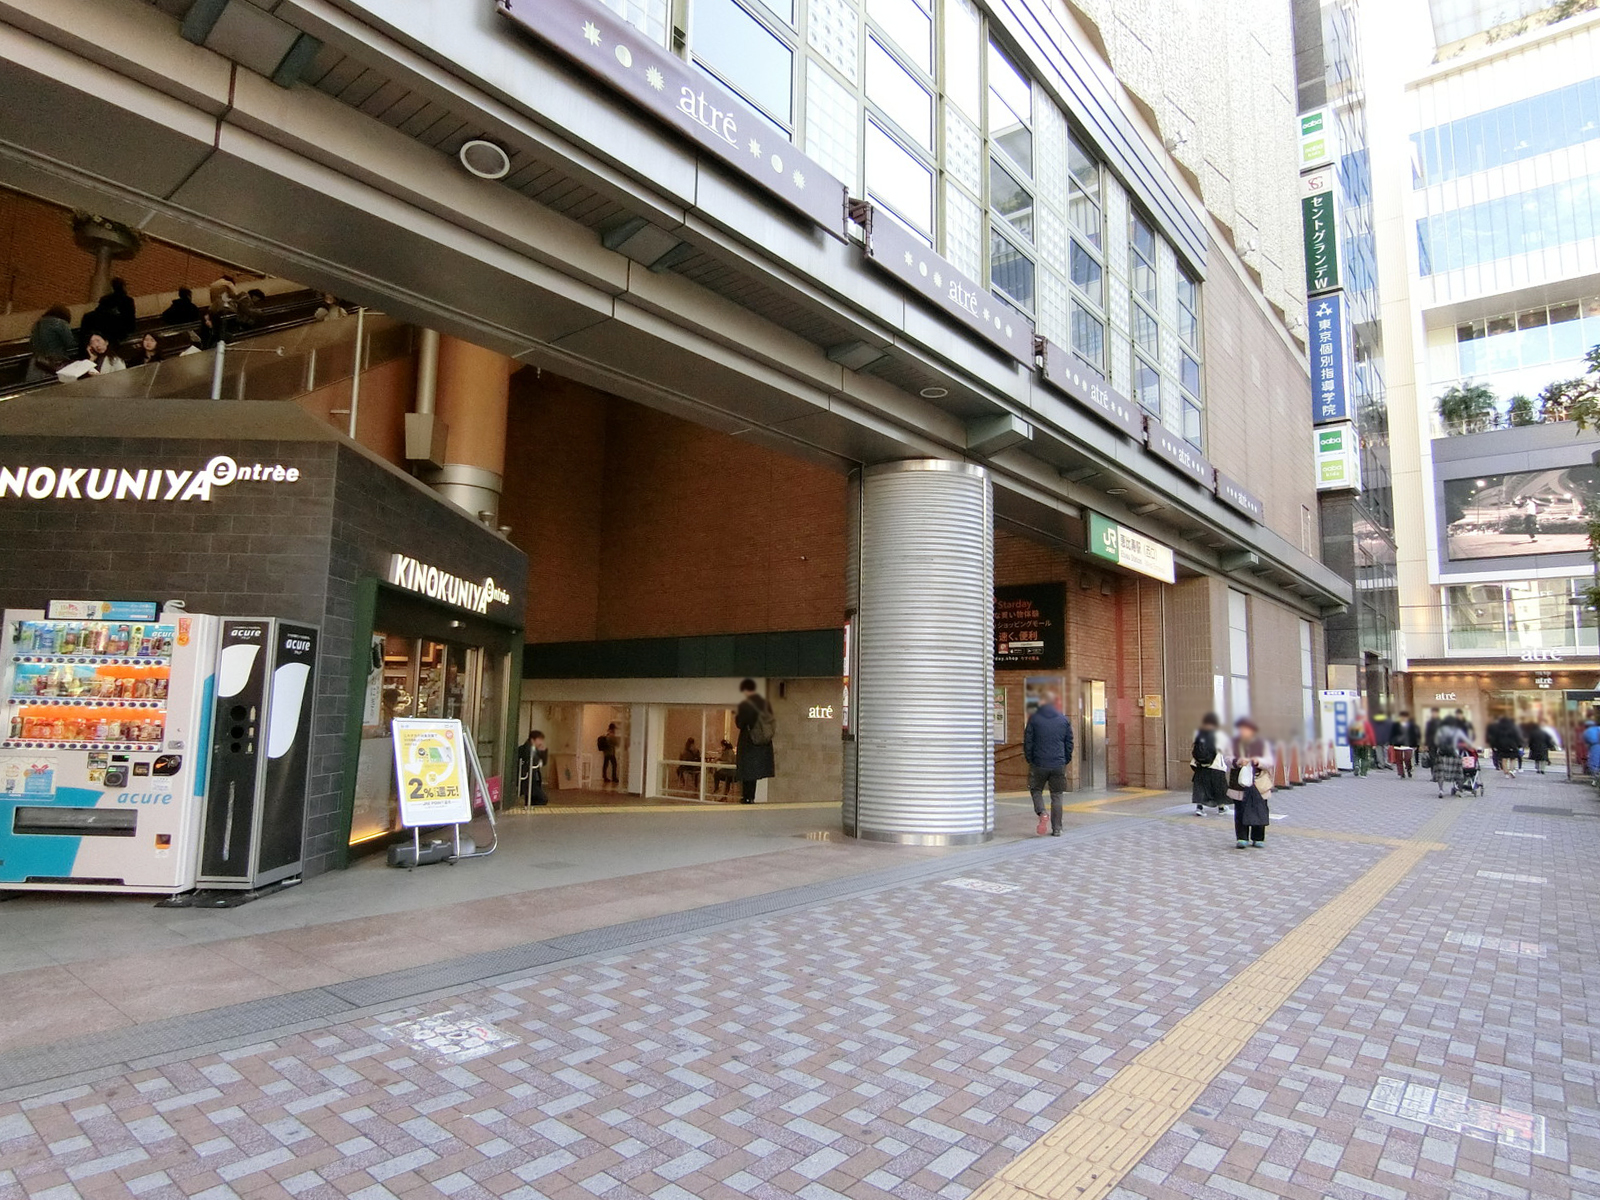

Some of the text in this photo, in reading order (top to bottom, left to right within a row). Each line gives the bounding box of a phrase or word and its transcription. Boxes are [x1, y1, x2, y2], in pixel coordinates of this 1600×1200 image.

[678, 84, 738, 148] atré
[1310, 197, 1328, 290] セントグランデW
[949, 280, 978, 318] atré
[1318, 319, 1337, 416] 東京個別指導学院
[1090, 384, 1109, 410] atré
[0, 467, 213, 501] NOKUNIYA
[1103, 527, 1117, 548] JR
[391, 553, 488, 614] KINOKUNIYA
[231, 629, 262, 637] acure
[994, 620, 1052, 629] ショッピングモール
[286, 639, 311, 651] acure
[808, 705, 833, 719] atré
[117, 791, 173, 805] acure
[408, 777, 434, 799] 2%
